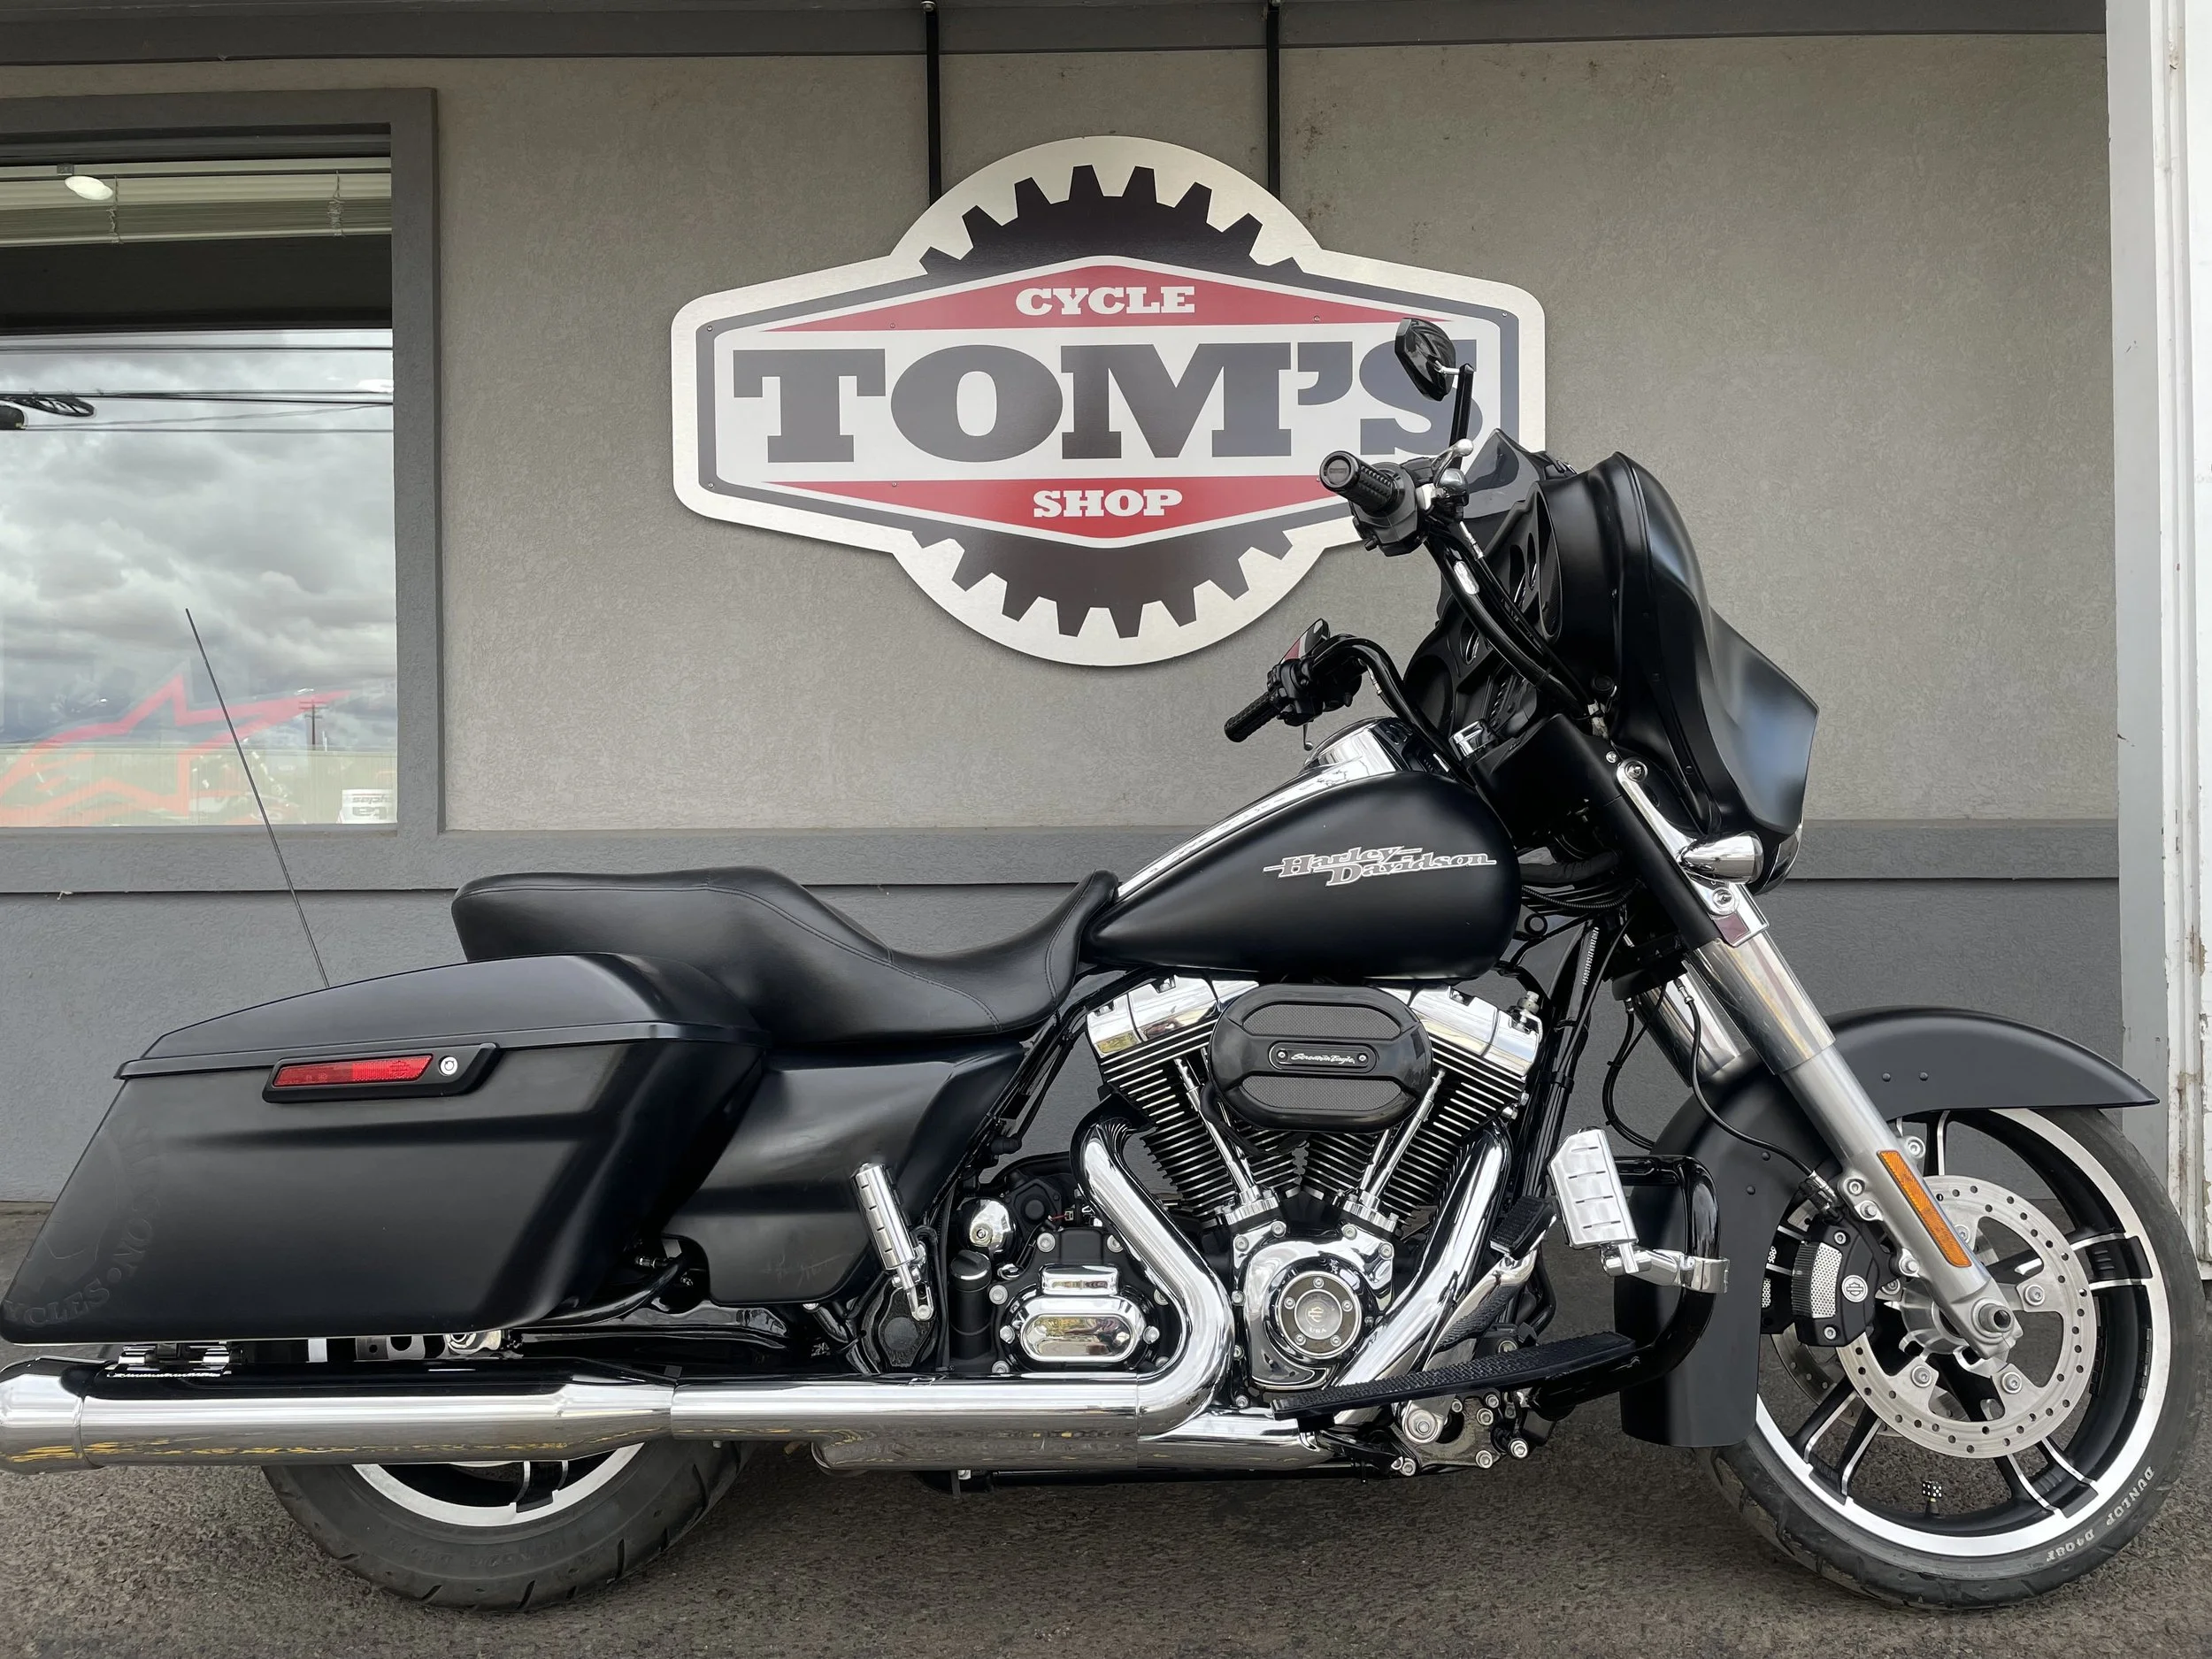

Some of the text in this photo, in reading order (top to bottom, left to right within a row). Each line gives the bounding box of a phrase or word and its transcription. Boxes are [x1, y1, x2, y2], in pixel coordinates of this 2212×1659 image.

[1016, 285, 1195, 316] CYCLE
[733, 339, 1484, 463] TOM'S
[1033, 488, 1183, 518] SHOP
[1274, 845, 1409, 877] Harley
[1325, 851, 1494, 886] Davidson
[2106, 1466, 2155, 1526] DUNLOP
